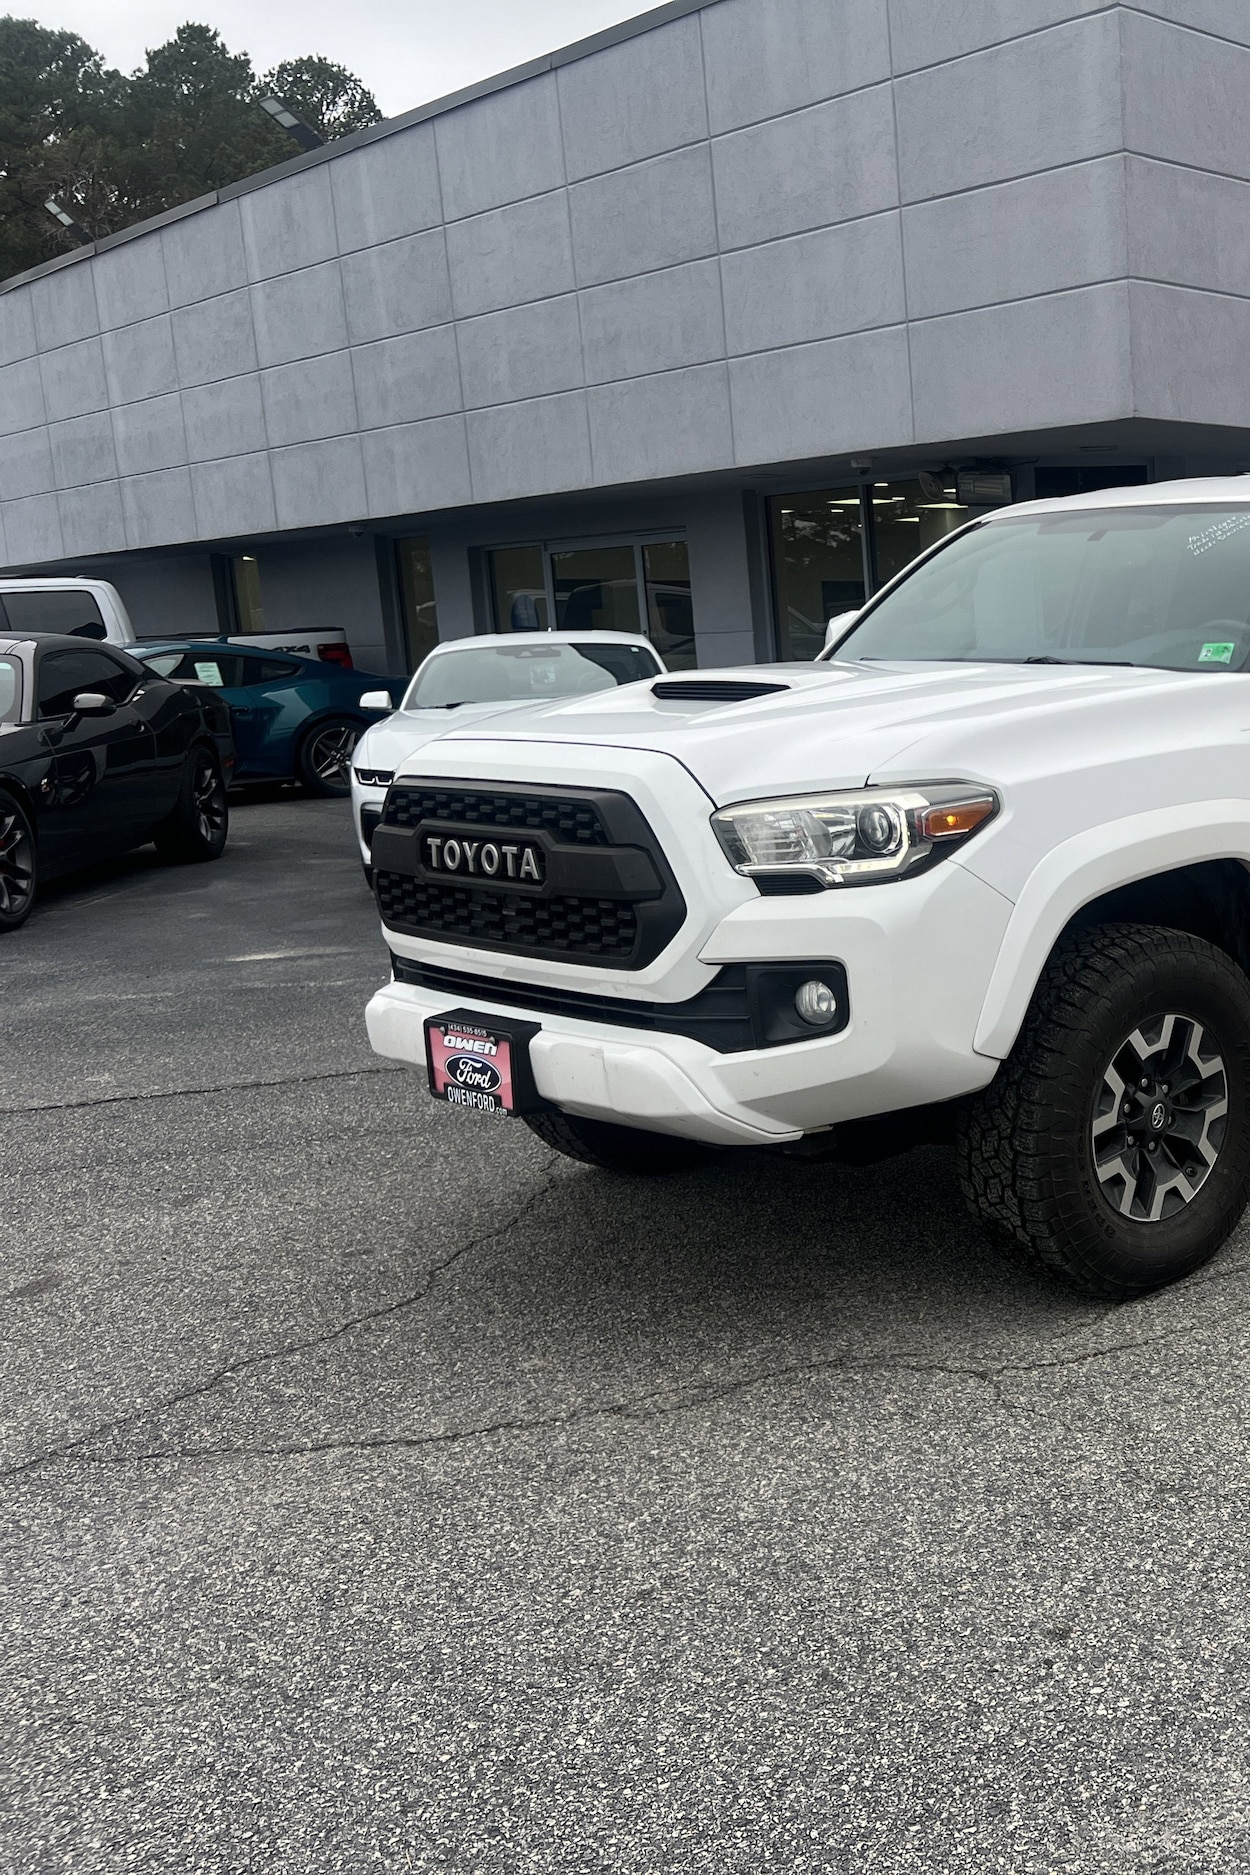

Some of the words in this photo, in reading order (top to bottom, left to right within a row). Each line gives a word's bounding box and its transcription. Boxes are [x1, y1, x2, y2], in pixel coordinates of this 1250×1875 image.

[426, 837, 541, 880] TOYOTA
[448, 1023, 462, 1032] (434)
[443, 1034, 498, 1056] OWEN
[456, 1058, 492, 1089] Ford
